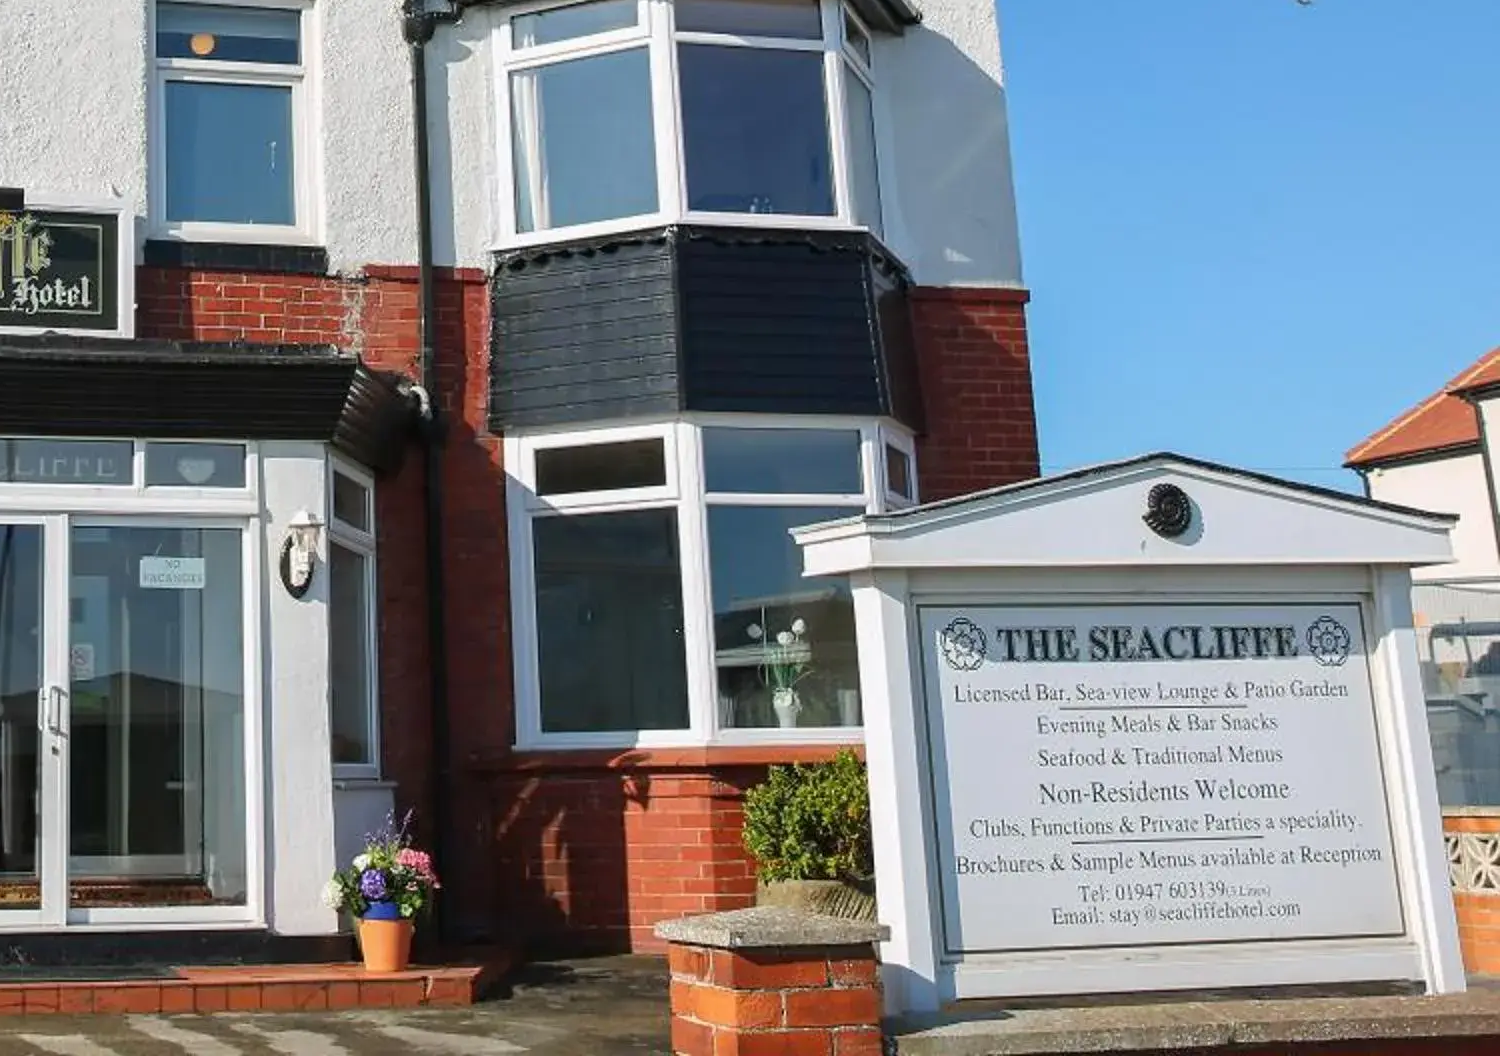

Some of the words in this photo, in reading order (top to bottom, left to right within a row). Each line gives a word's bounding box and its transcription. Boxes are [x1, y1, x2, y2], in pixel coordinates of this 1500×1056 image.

[10, 276, 92, 315] Hotel
[997, 625, 1080, 662] THE
[1088, 624, 1299, 662] SEACLIFFE
[954, 683, 1031, 703] Licensed
[1036, 684, 1071, 704] Bar,
[1075, 683, 1151, 701] Sea-view
[1157, 681, 1218, 704] Lounge
[1225, 682, 1239, 699] &
[1244, 680, 1285, 699] Patio
[1290, 679, 1349, 697] Garden
[1037, 716, 1107, 738] Evening
[1111, 714, 1161, 733] Meals
[1167, 714, 1182, 732] &
[1188, 714, 1216, 732] Bar
[1221, 712, 1279, 731] Snacks
[1039, 748, 1105, 767] Seafood
[1111, 748, 1126, 765] &
[1131, 745, 1223, 765] Traditional
[1229, 746, 1283, 763] Menus
[1039, 780, 1189, 805] Non-Residents
[1194, 778, 1290, 800] Welcome
[1031, 817, 1114, 836] Functions
[1119, 815, 1135, 833] &
[1140, 814, 1199, 833] Private
[1204, 811, 1261, 831] Parties
[1265, 818, 1275, 829] a
[1280, 809, 1364, 833] speciality.
[956, 855, 1045, 875] Brochures
[1050, 853, 1065, 871] &
[1071, 852, 1135, 875] Sample
[1140, 851, 1197, 869] Menus
[1201, 847, 1276, 867] available
[1281, 849, 1296, 865] at
[1300, 844, 1382, 868] Reception
[1078, 885, 1110, 903] Tel:
[1115, 884, 1163, 902] 01947
[1051, 906, 1104, 926] Email:
